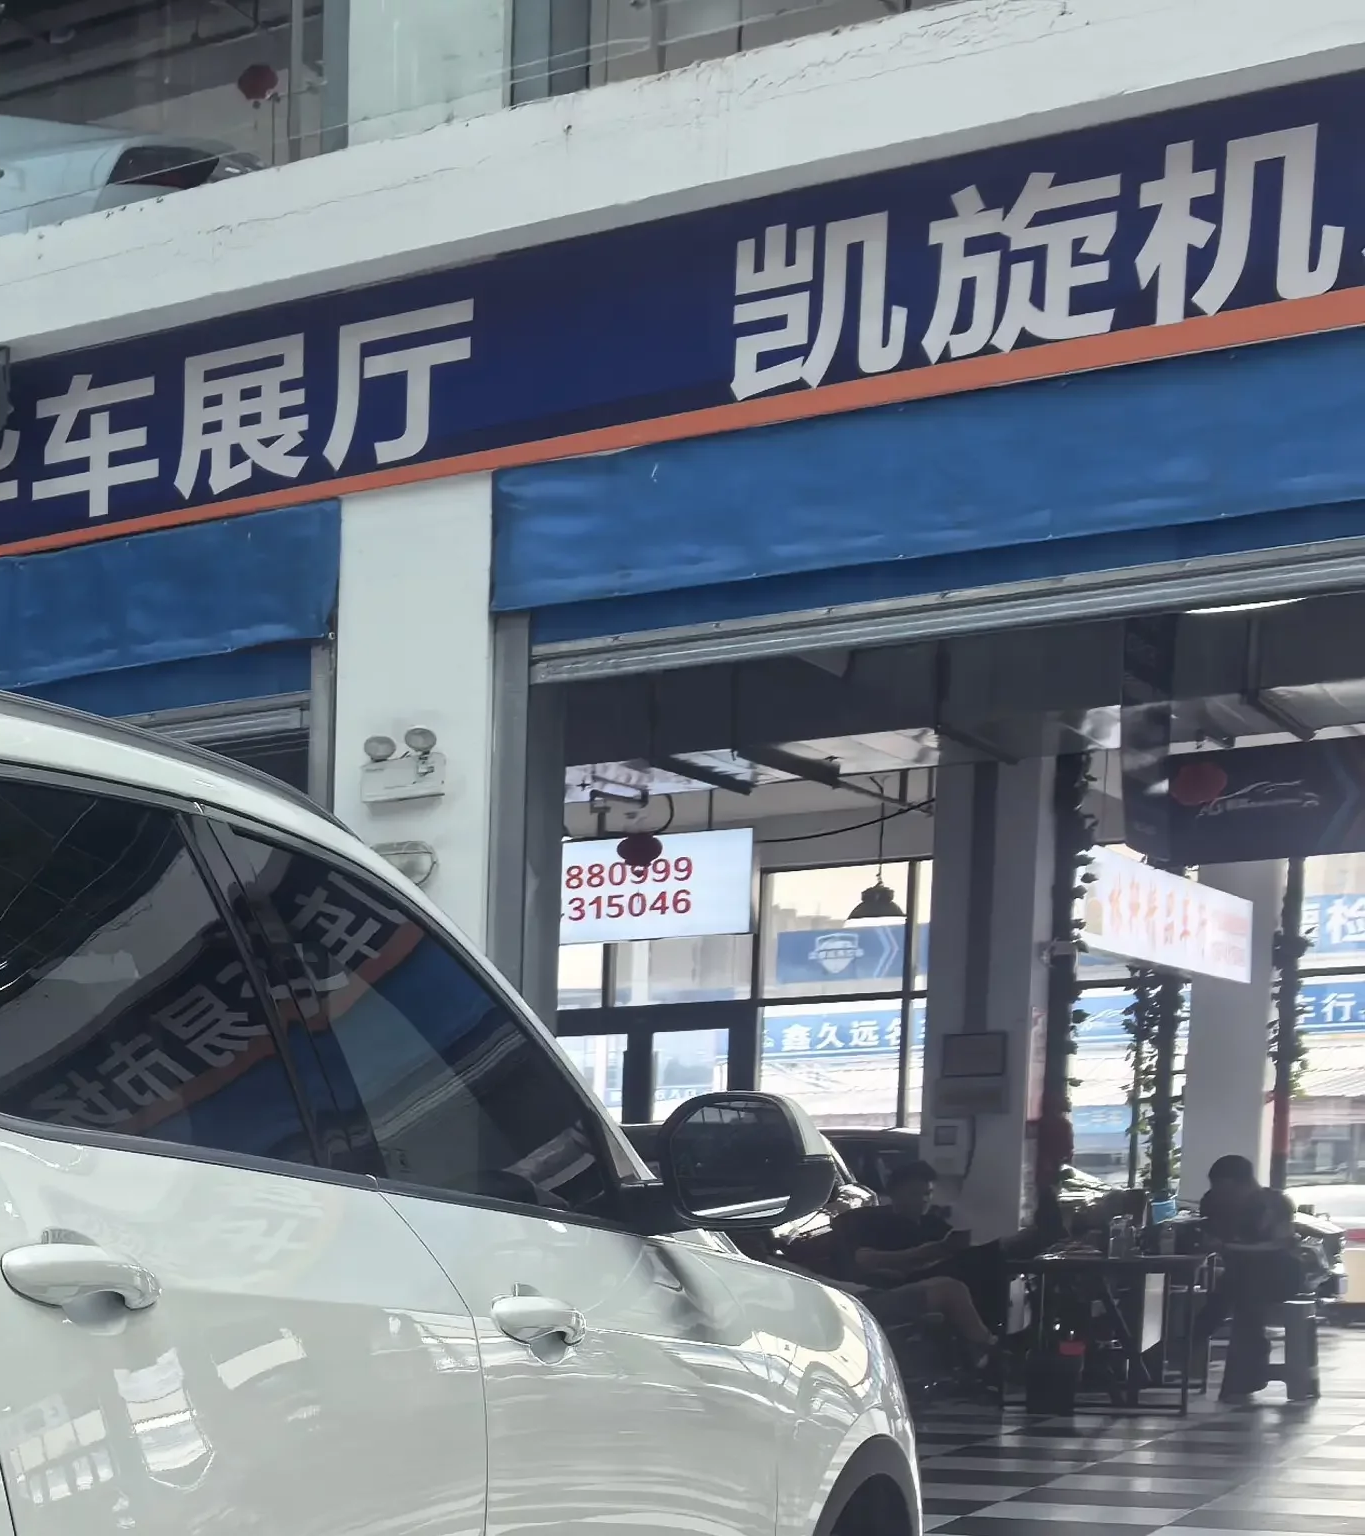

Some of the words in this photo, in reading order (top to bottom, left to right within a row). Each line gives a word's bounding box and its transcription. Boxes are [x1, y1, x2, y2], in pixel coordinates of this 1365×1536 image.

[730, 122, 1365, 401] 凯旋机
[565, 856, 693, 889] 880999
[560, 889, 692, 921] 315046
[781, 1017, 926, 1052] 鑫久远名
